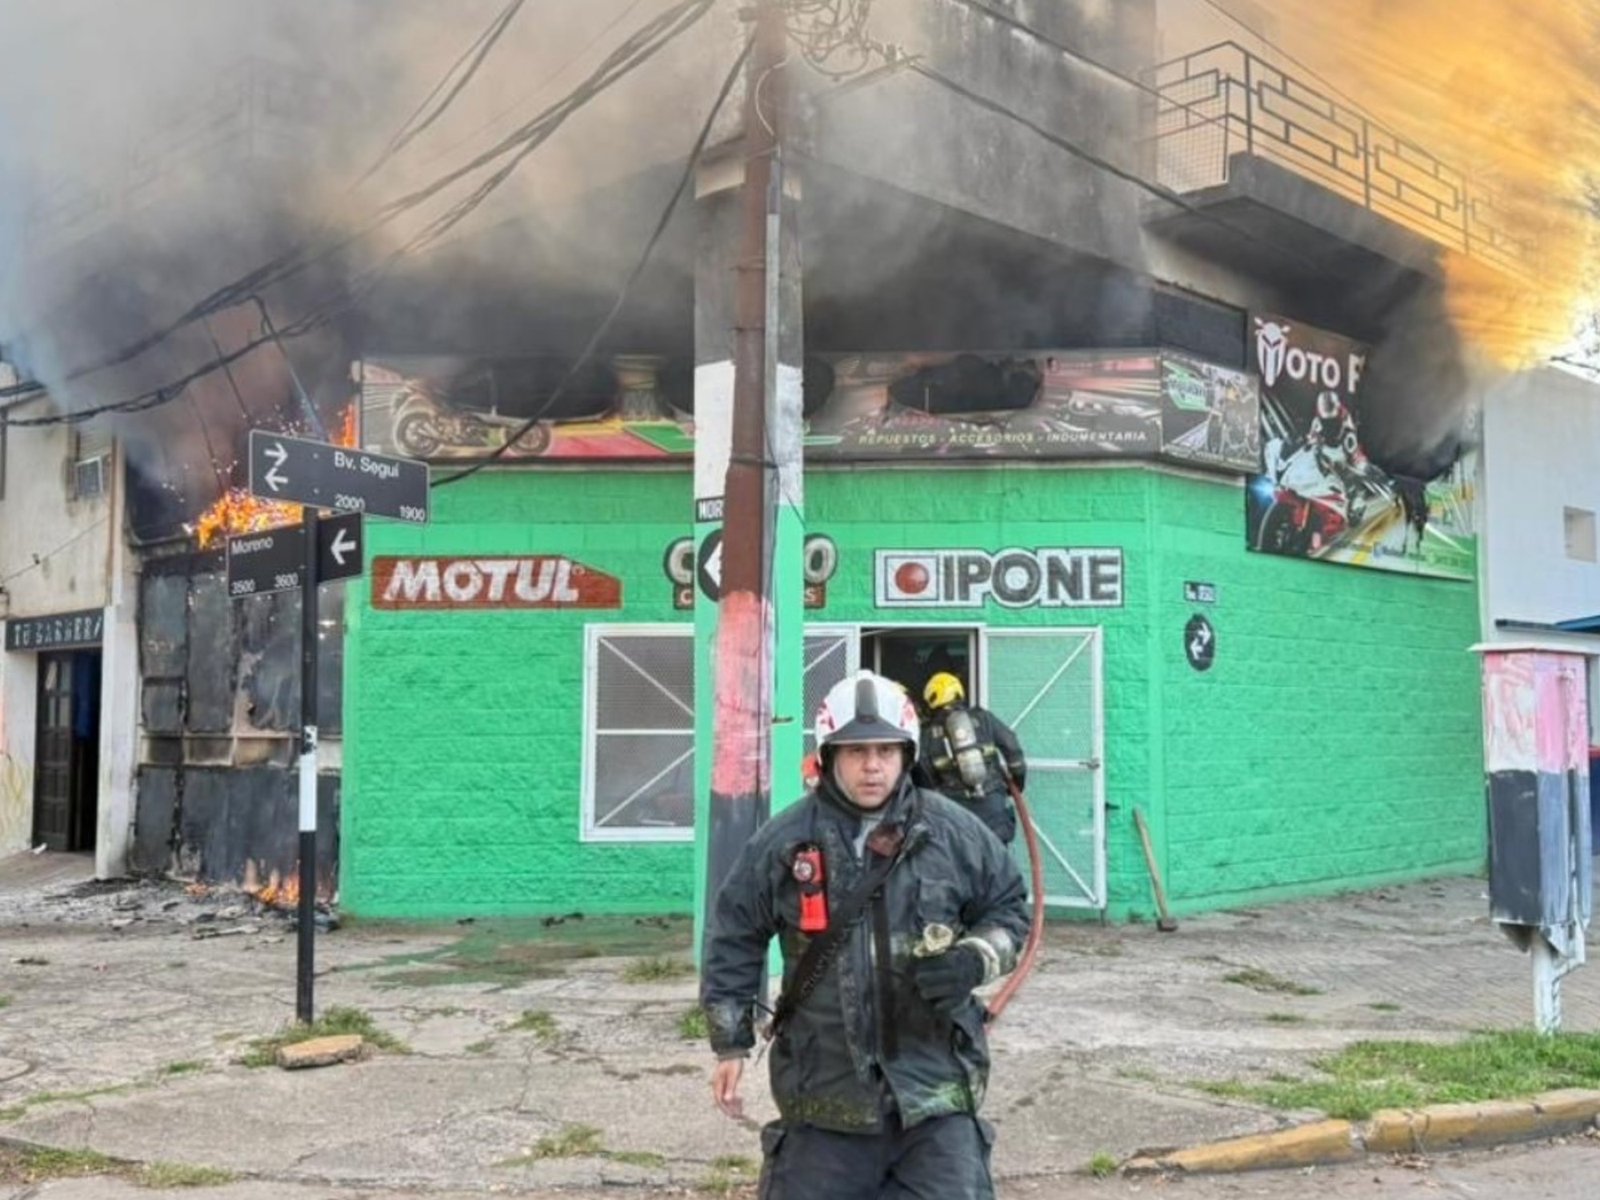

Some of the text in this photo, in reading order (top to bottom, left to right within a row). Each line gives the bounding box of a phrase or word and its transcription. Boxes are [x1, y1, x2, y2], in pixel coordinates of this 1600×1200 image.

[858, 432, 937, 446] REPUESTOS
[1046, 430, 1147, 443] INDUMENTARIA
[334, 450, 356, 470] Bv.
[335, 493, 426, 521] 2000 1900
[231, 536, 274, 555] Moreno
[231, 571, 299, 594] 3500 3600
[383, 559, 580, 601] MOTUL
[943, 553, 1120, 603] IPONE
